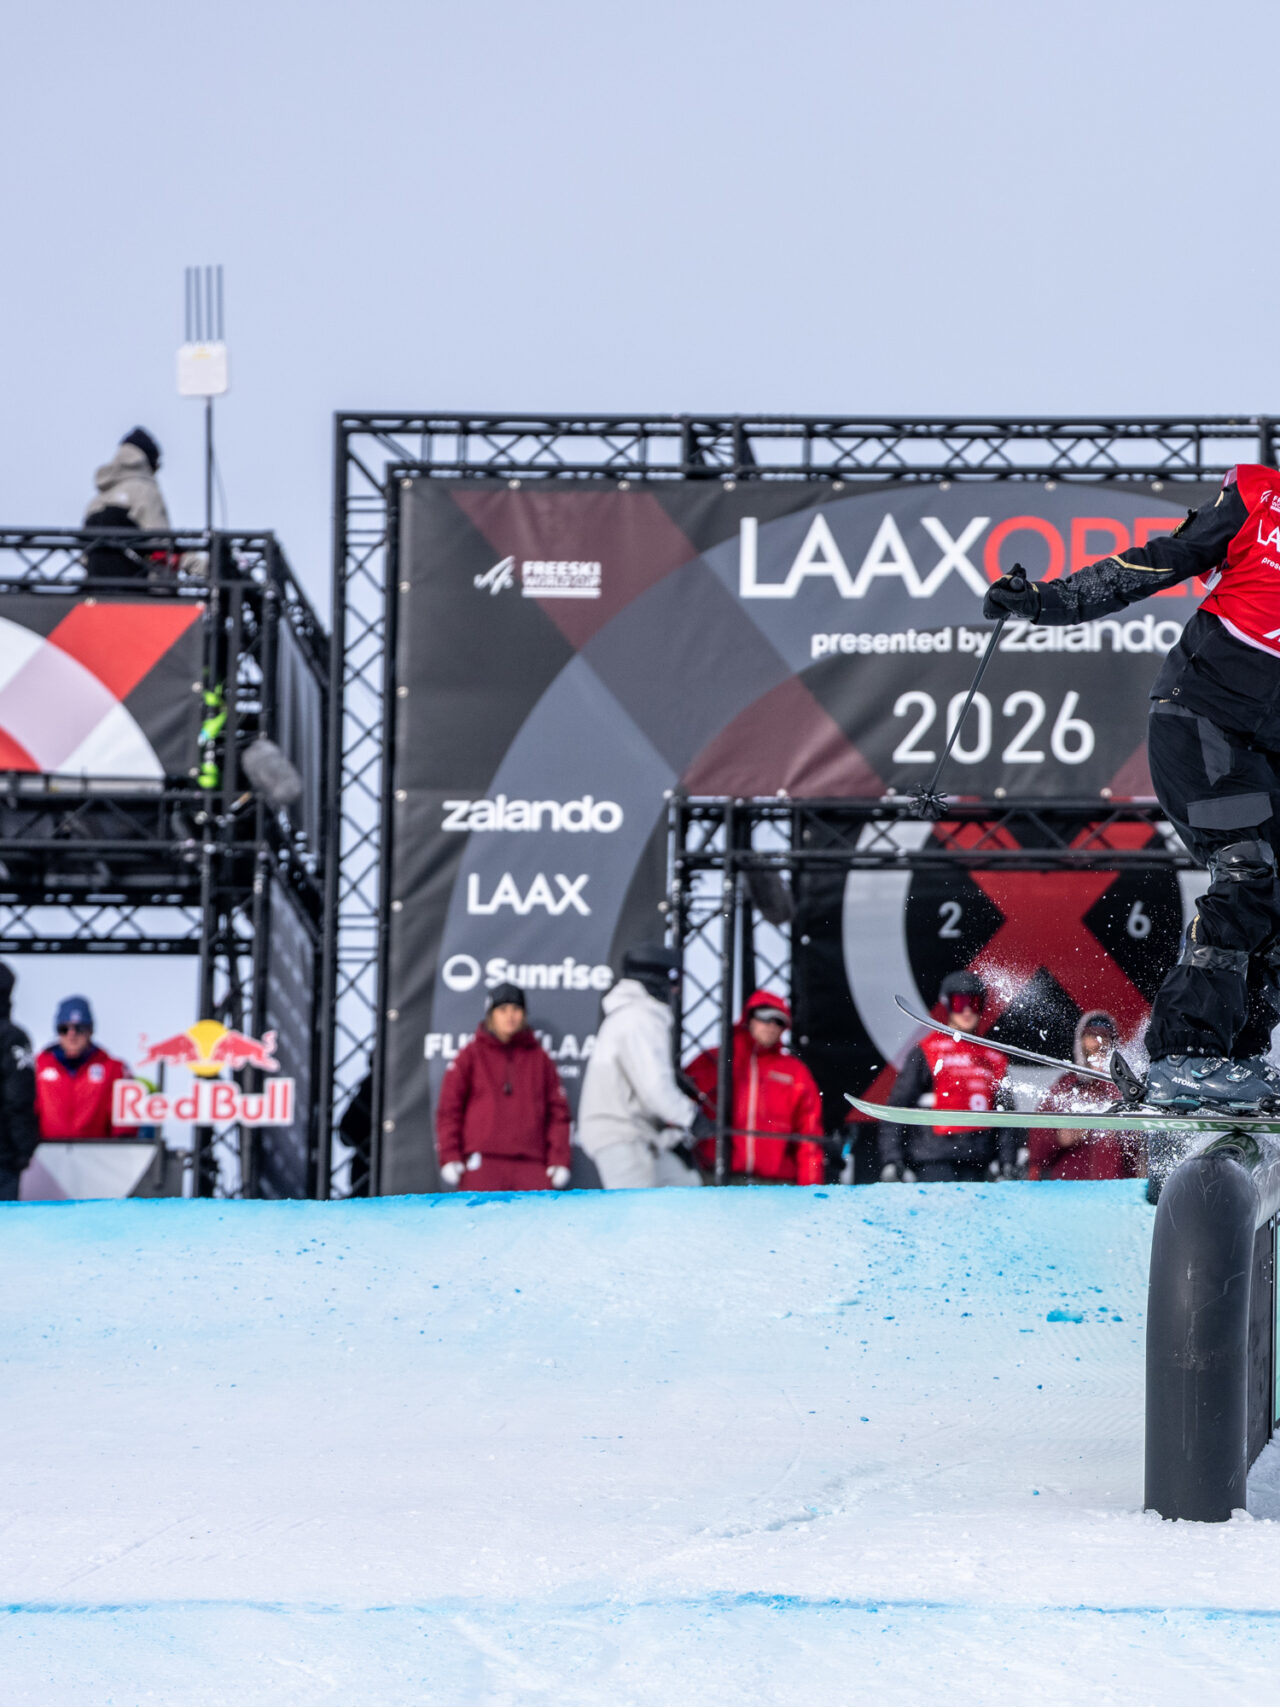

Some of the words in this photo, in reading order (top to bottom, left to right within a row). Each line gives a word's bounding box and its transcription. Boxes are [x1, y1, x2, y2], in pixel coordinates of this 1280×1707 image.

[811, 628, 951, 659] presented
[958, 625, 994, 656] by
[1000, 615, 1185, 653] zalando
[892, 690, 1095, 764] 2026
[442, 795, 624, 833] zalando
[467, 873, 591, 916] LAAX
[939, 902, 961, 938] 2
[1127, 902, 1151, 939] 6
[484, 957, 615, 992] Sunrise
[120, 1082, 200, 1120] Red
[210, 1082, 290, 1121] Bull
[1171, 1076, 1201, 1091] ATOMIC
[1143, 1120, 1272, 1132] FACTION
